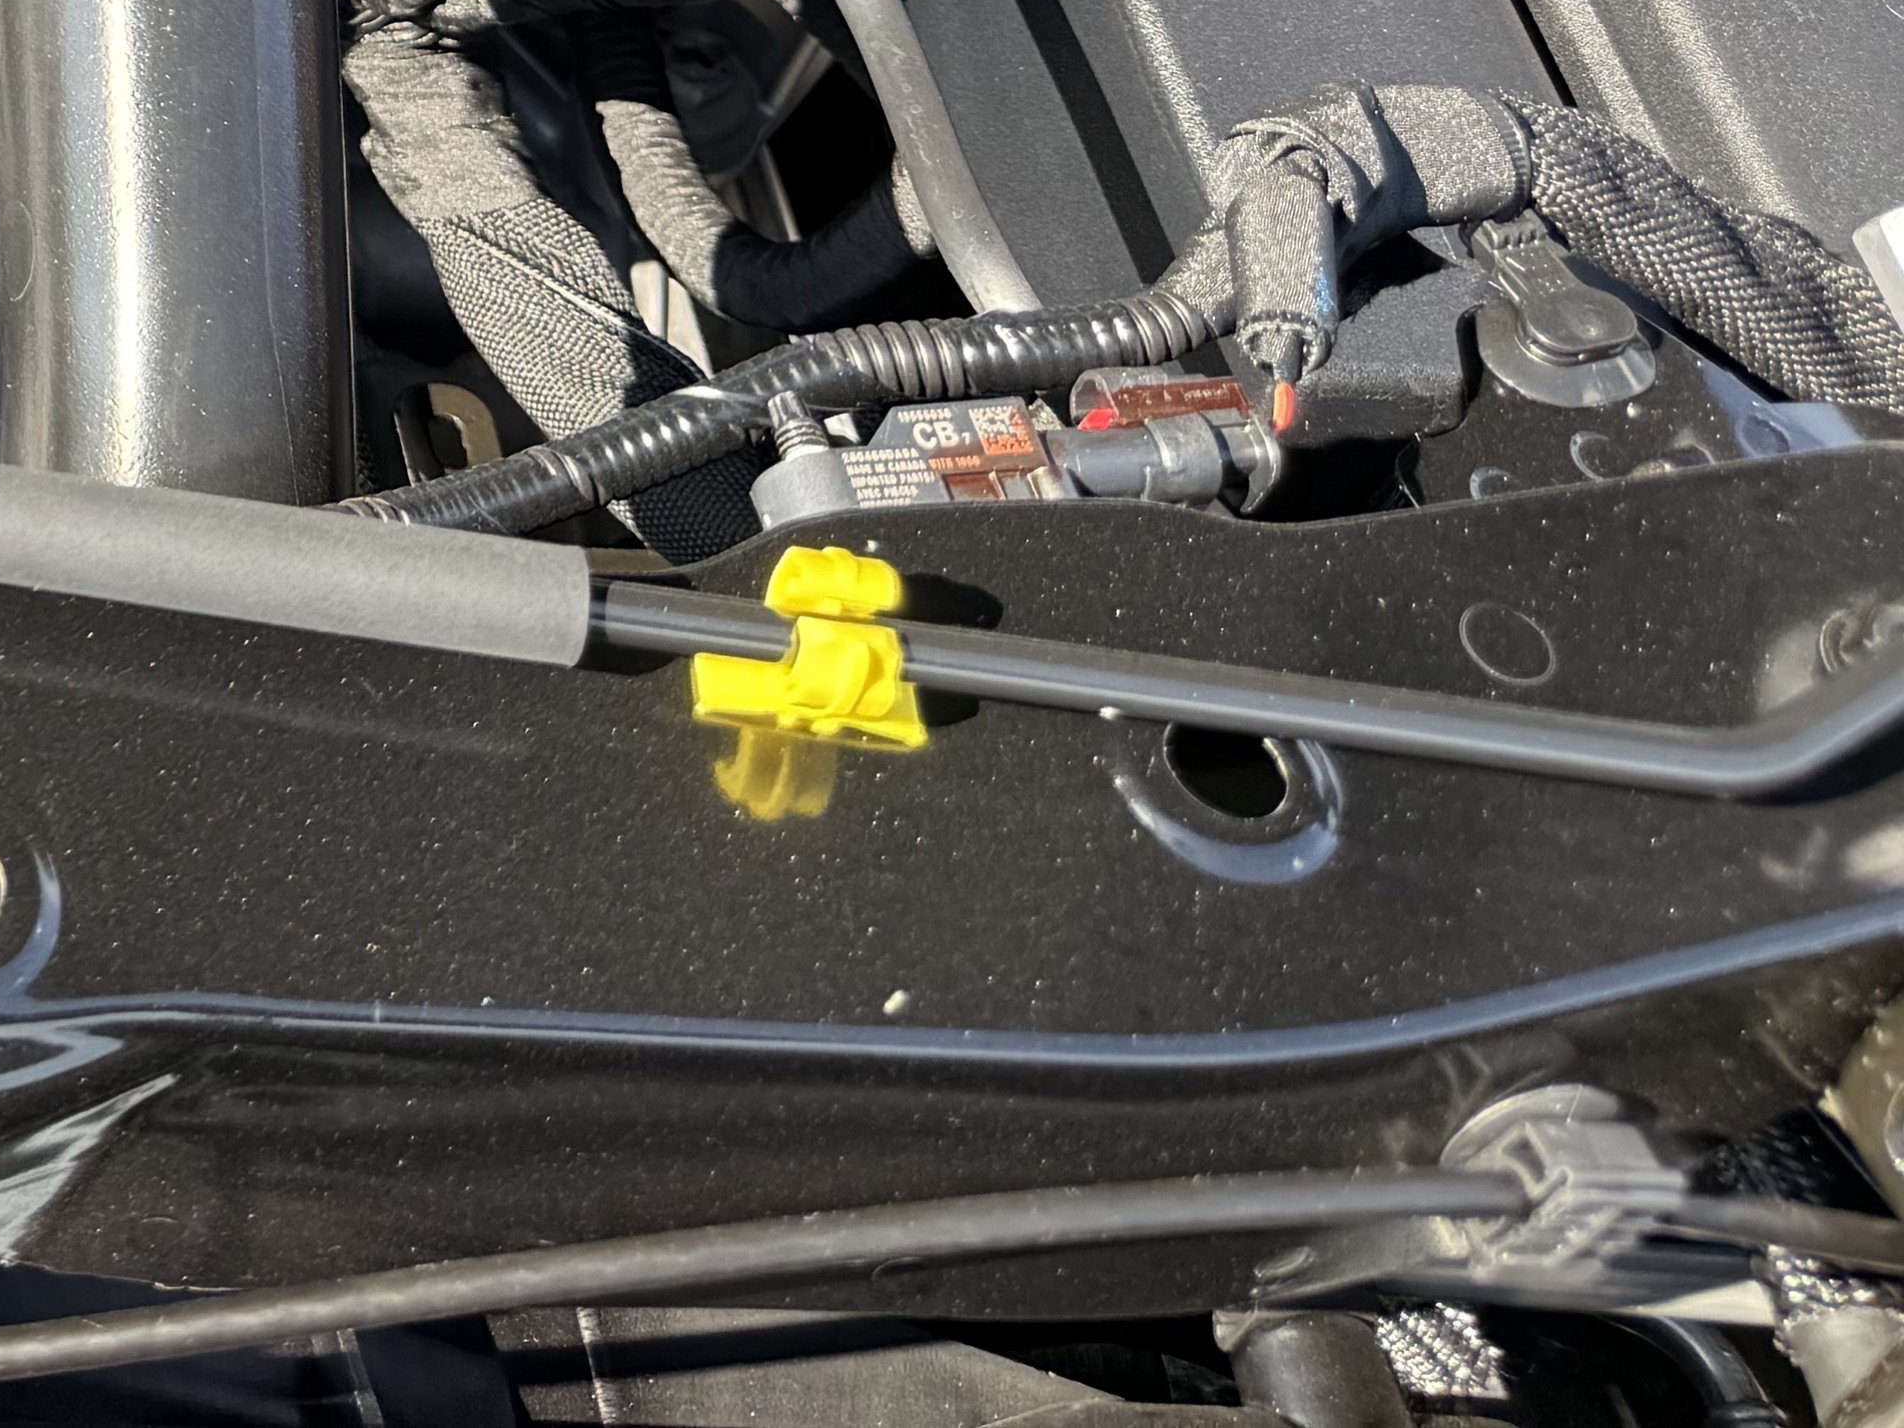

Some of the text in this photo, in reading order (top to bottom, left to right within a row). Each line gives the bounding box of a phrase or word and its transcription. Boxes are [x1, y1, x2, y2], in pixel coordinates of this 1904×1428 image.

[913, 421, 960, 450] CB
[846, 463, 872, 476] MADE
[874, 462, 886, 473] IN
[888, 459, 927, 472] CANADA
[851, 474, 898, 488] IMPORTED
[856, 487, 882, 500] AVEC
